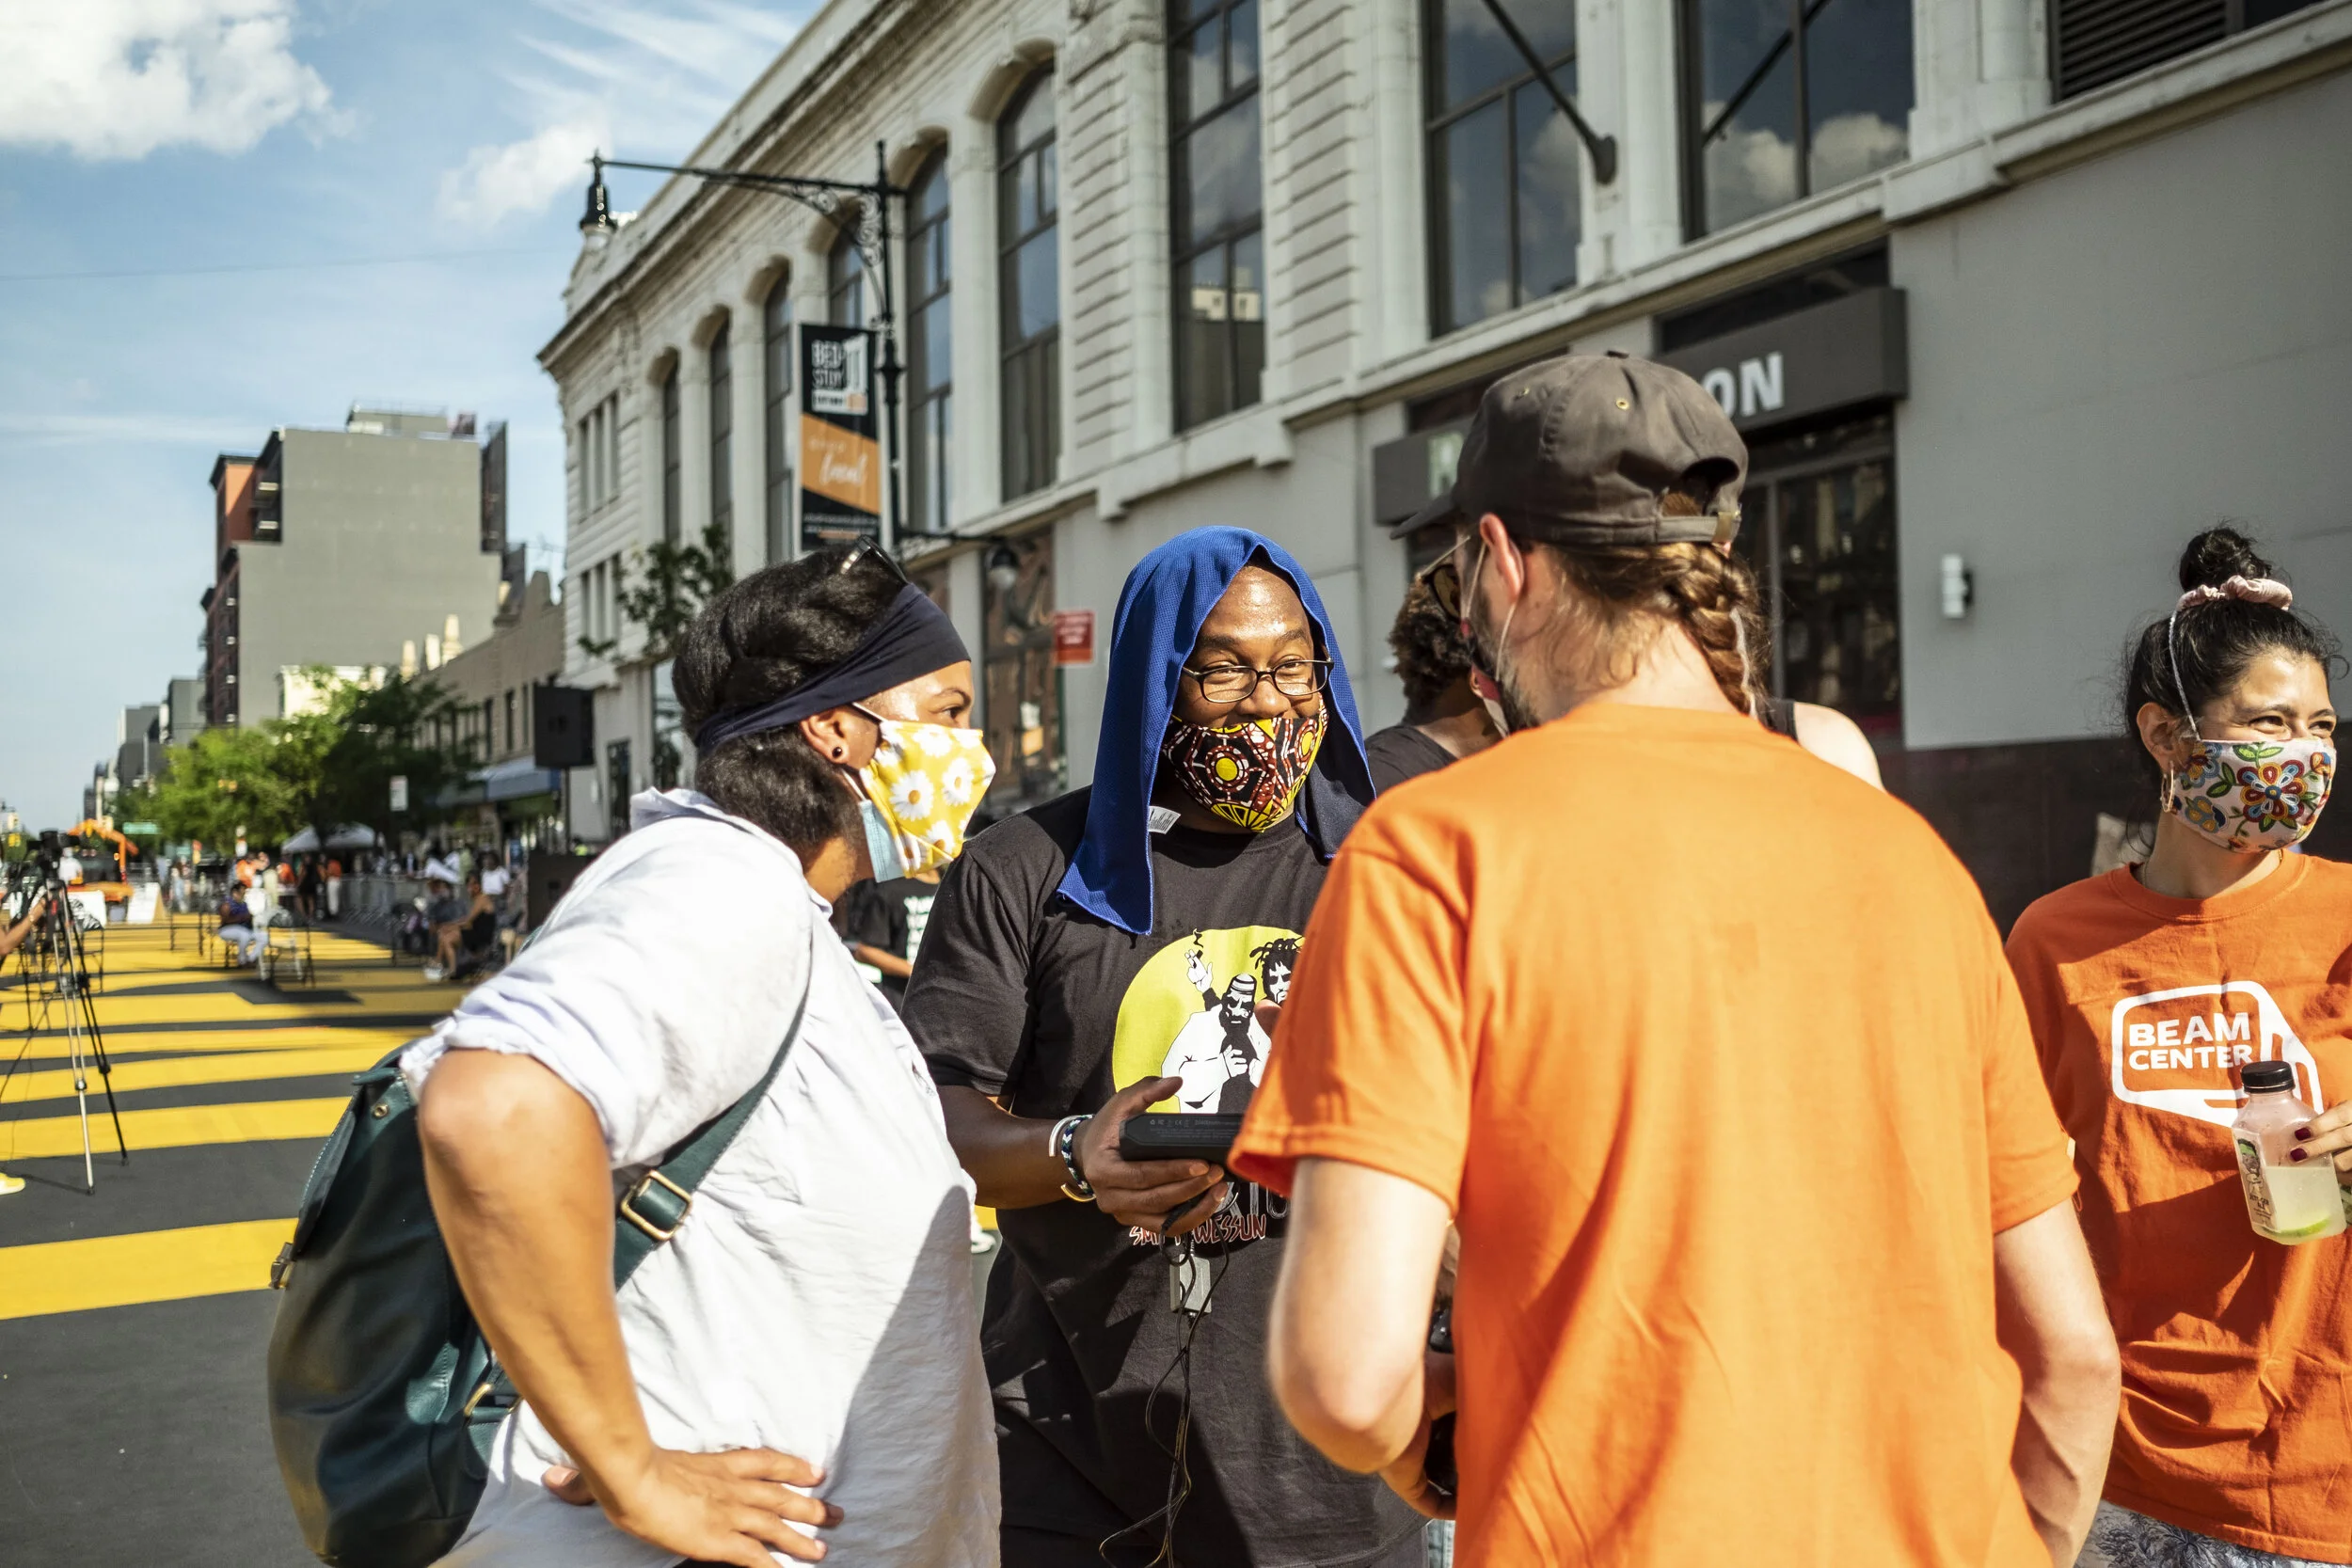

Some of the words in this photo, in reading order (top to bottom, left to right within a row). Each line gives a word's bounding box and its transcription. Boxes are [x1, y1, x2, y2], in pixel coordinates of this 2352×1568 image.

[2129, 1012, 2251, 1047] BEAM
[2129, 1044, 2253, 1070] CENTER
[1193, 1213, 1267, 1244] WESSUN
